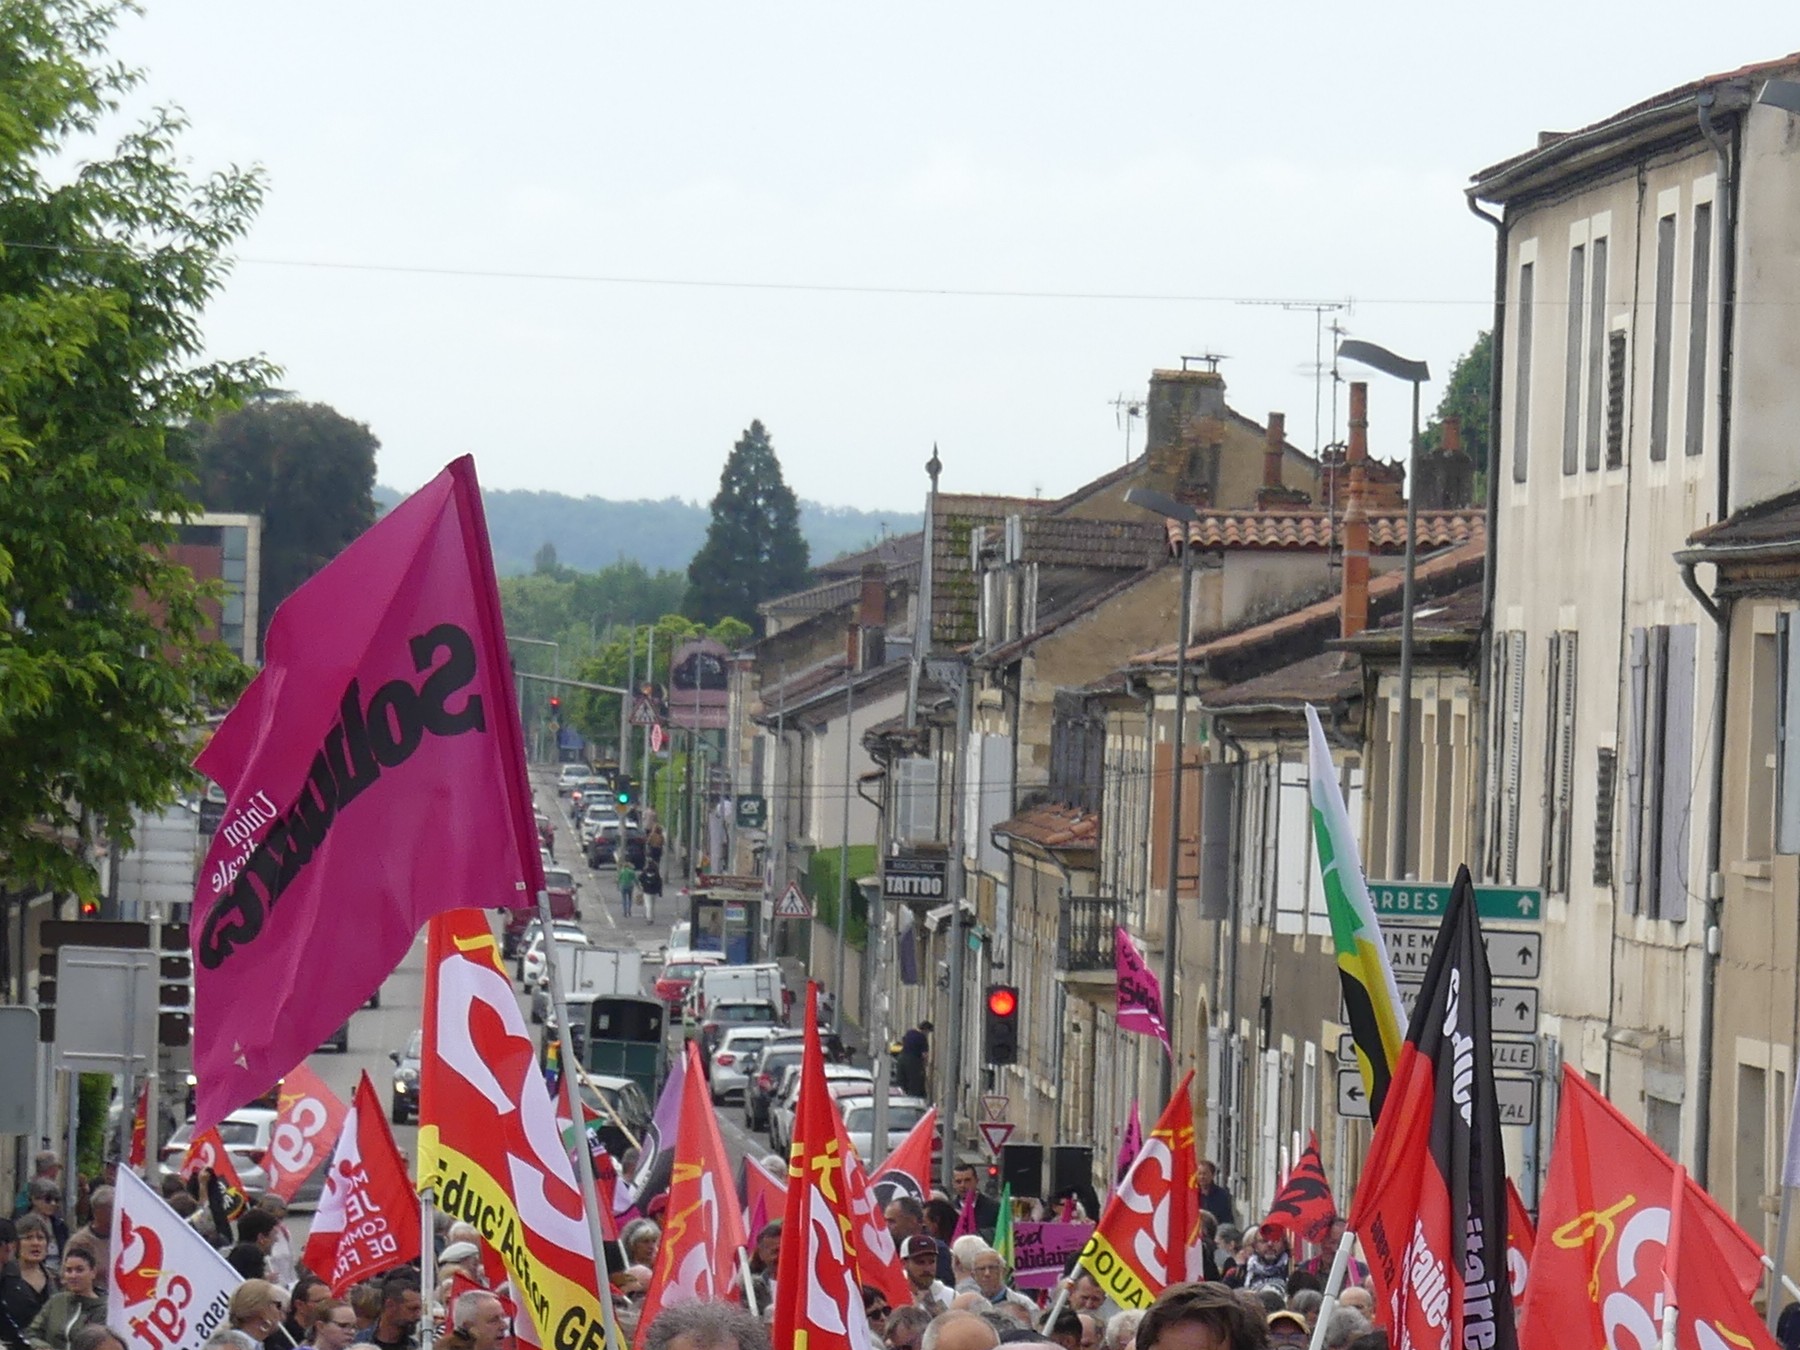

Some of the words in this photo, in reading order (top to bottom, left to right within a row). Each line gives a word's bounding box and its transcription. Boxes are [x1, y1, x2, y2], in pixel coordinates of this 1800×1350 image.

[886, 876, 942, 895] TATTOO
[1370, 892, 1439, 911] ARBES
[1493, 1048, 1530, 1063] ILLE
[1079, 1236, 1152, 1310] DOUA
